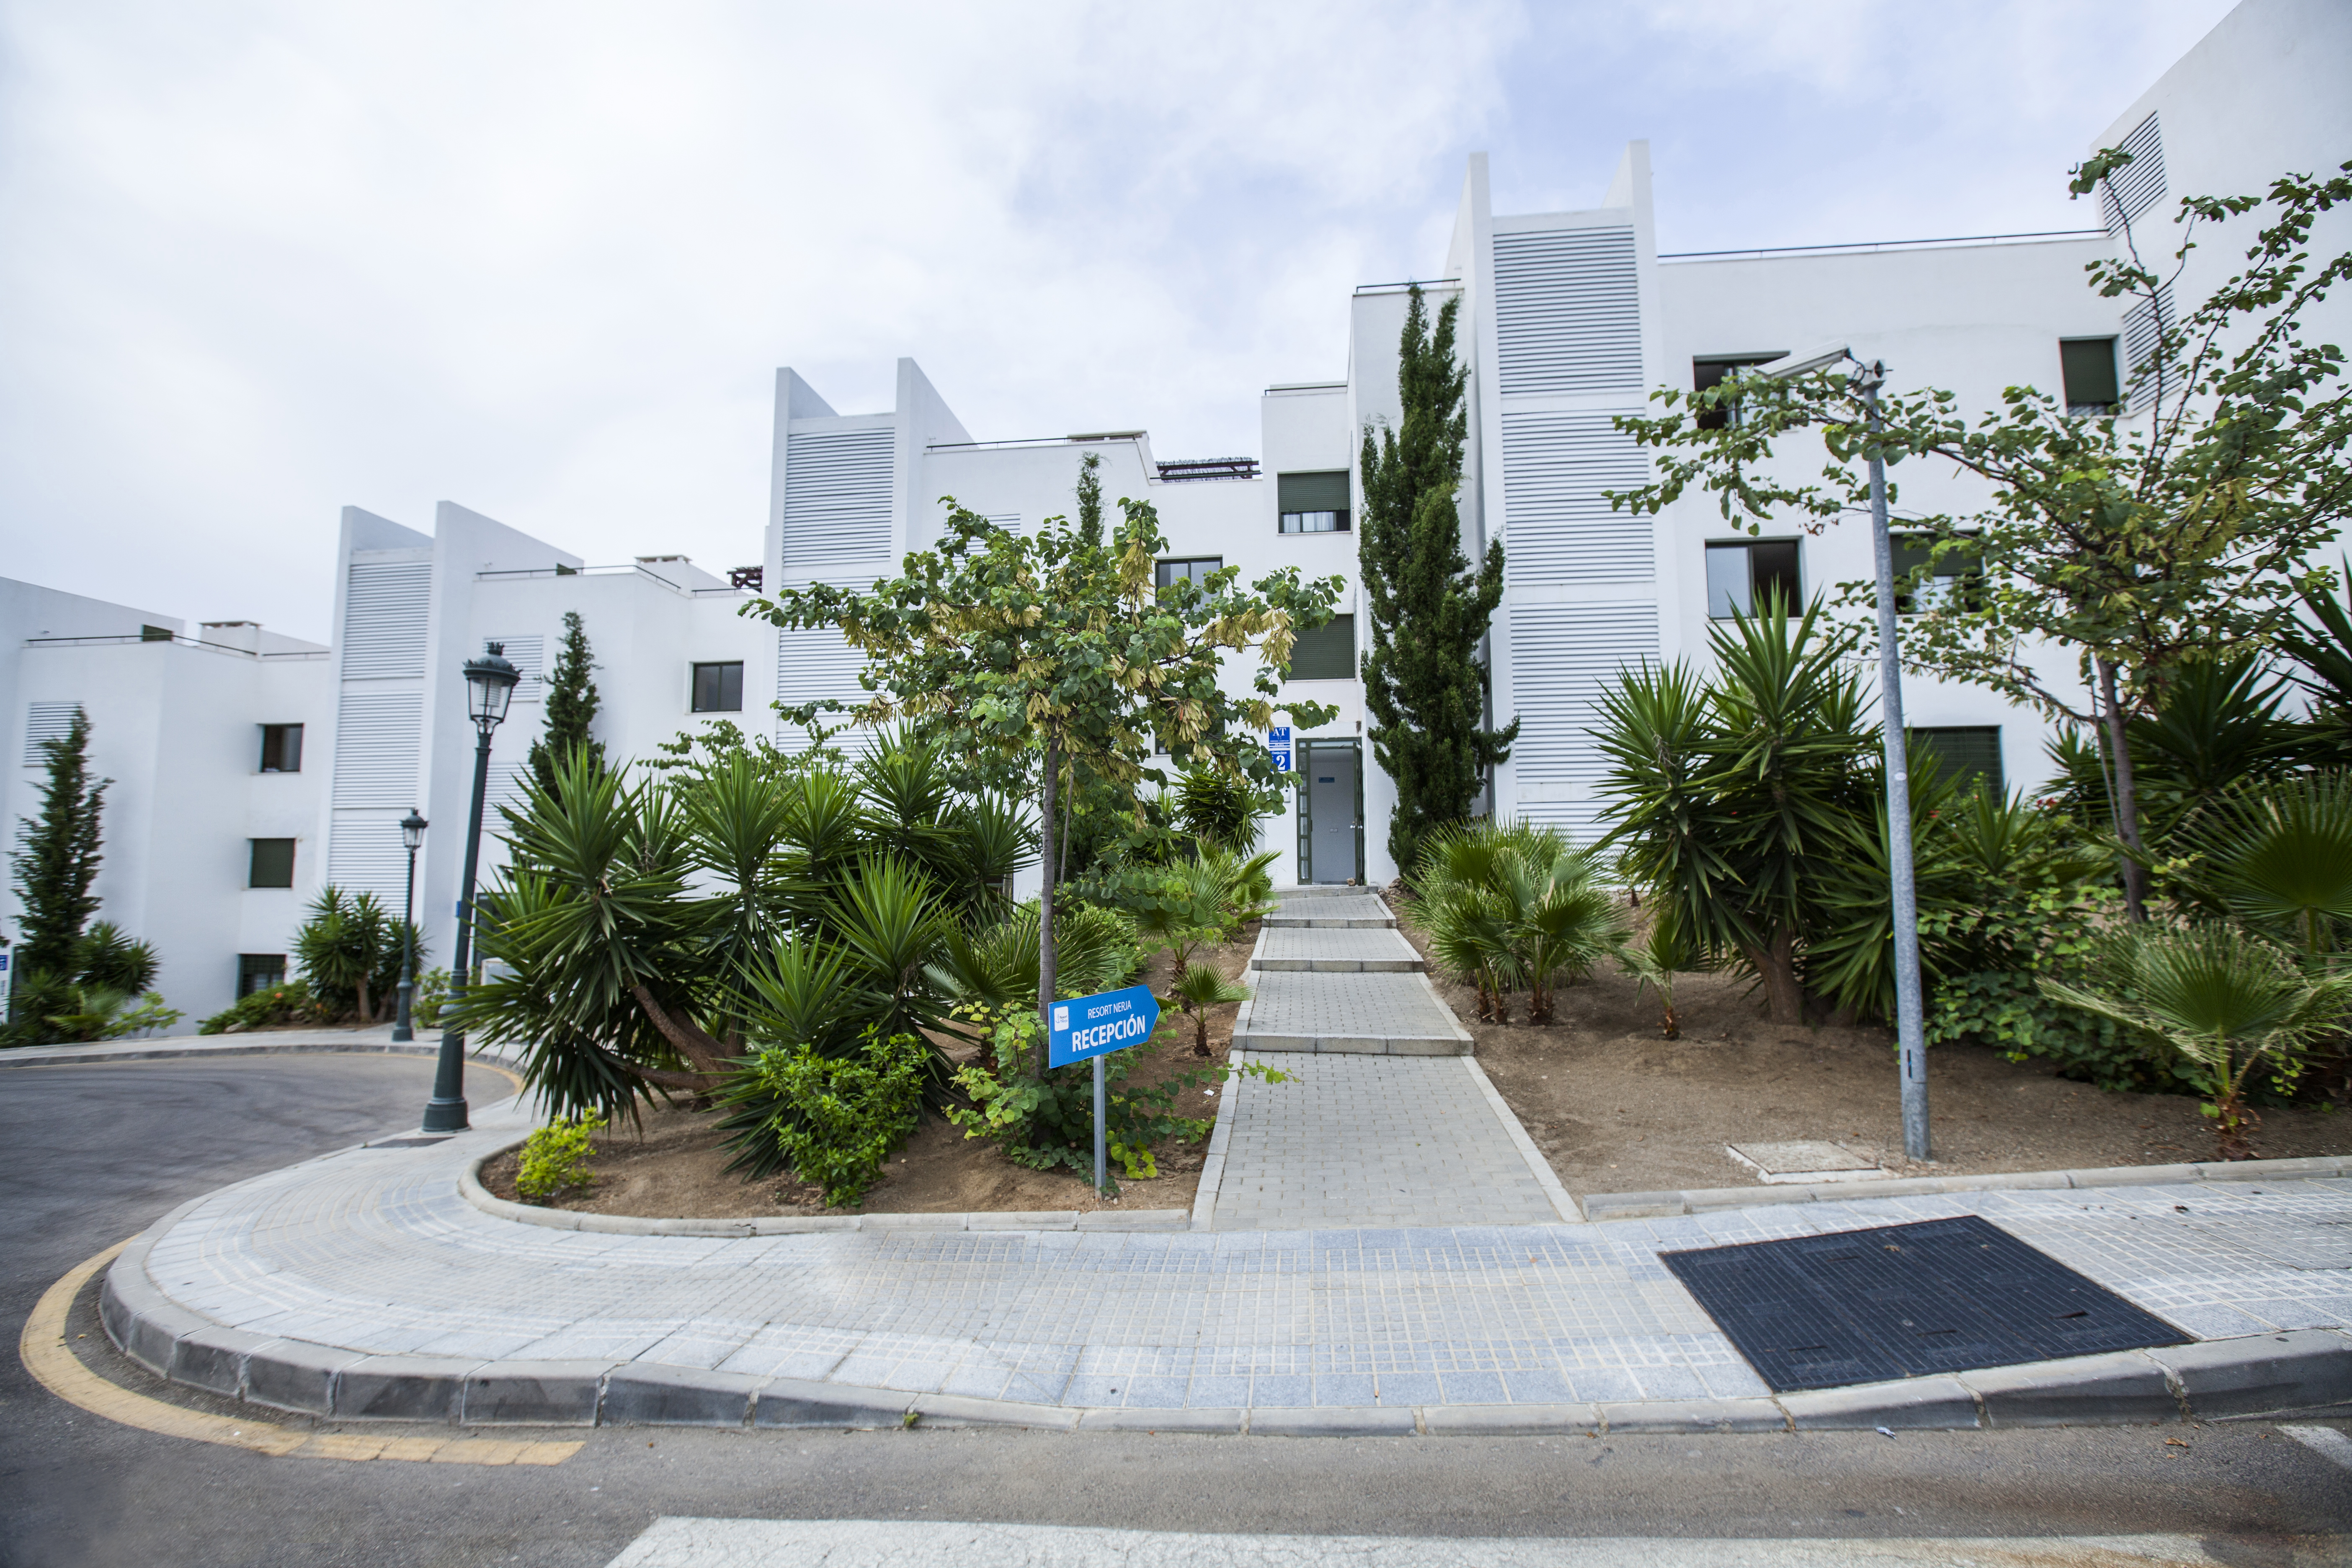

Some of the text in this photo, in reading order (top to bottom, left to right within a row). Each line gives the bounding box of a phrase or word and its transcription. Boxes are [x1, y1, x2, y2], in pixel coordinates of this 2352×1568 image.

[1272, 727, 1287, 736] AT
[1276, 755, 1286, 771] 2
[1088, 1000, 1132, 1019] RESORT NERJA
[1072, 1014, 1145, 1052] RECEPCIÓN
